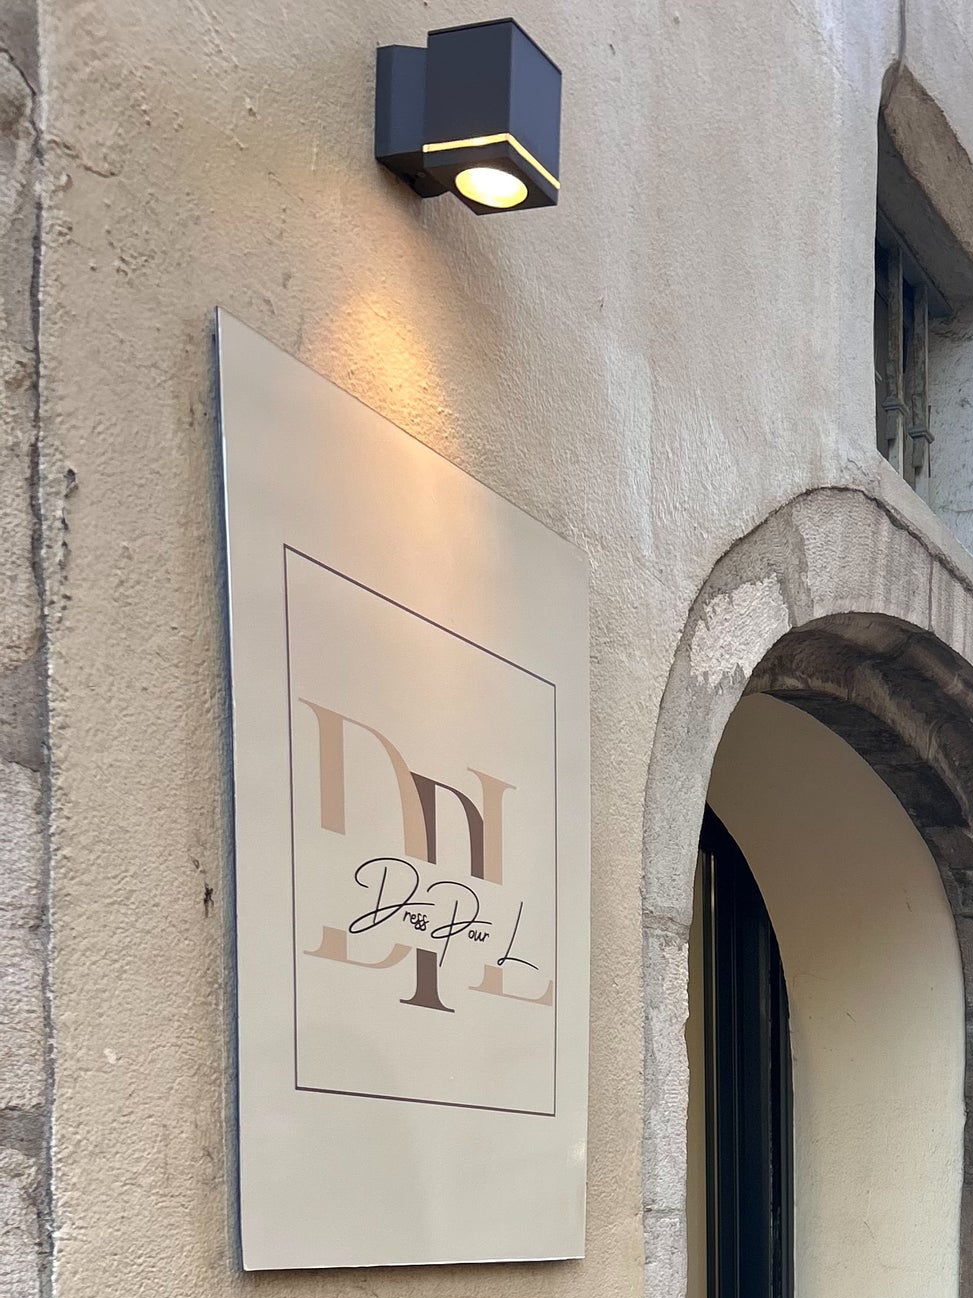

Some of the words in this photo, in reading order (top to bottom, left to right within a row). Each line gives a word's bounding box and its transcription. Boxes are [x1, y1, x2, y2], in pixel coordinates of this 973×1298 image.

[349, 858, 435, 934] Dress
[427, 881, 492, 967] Pour
[497, 901, 539, 970] L
